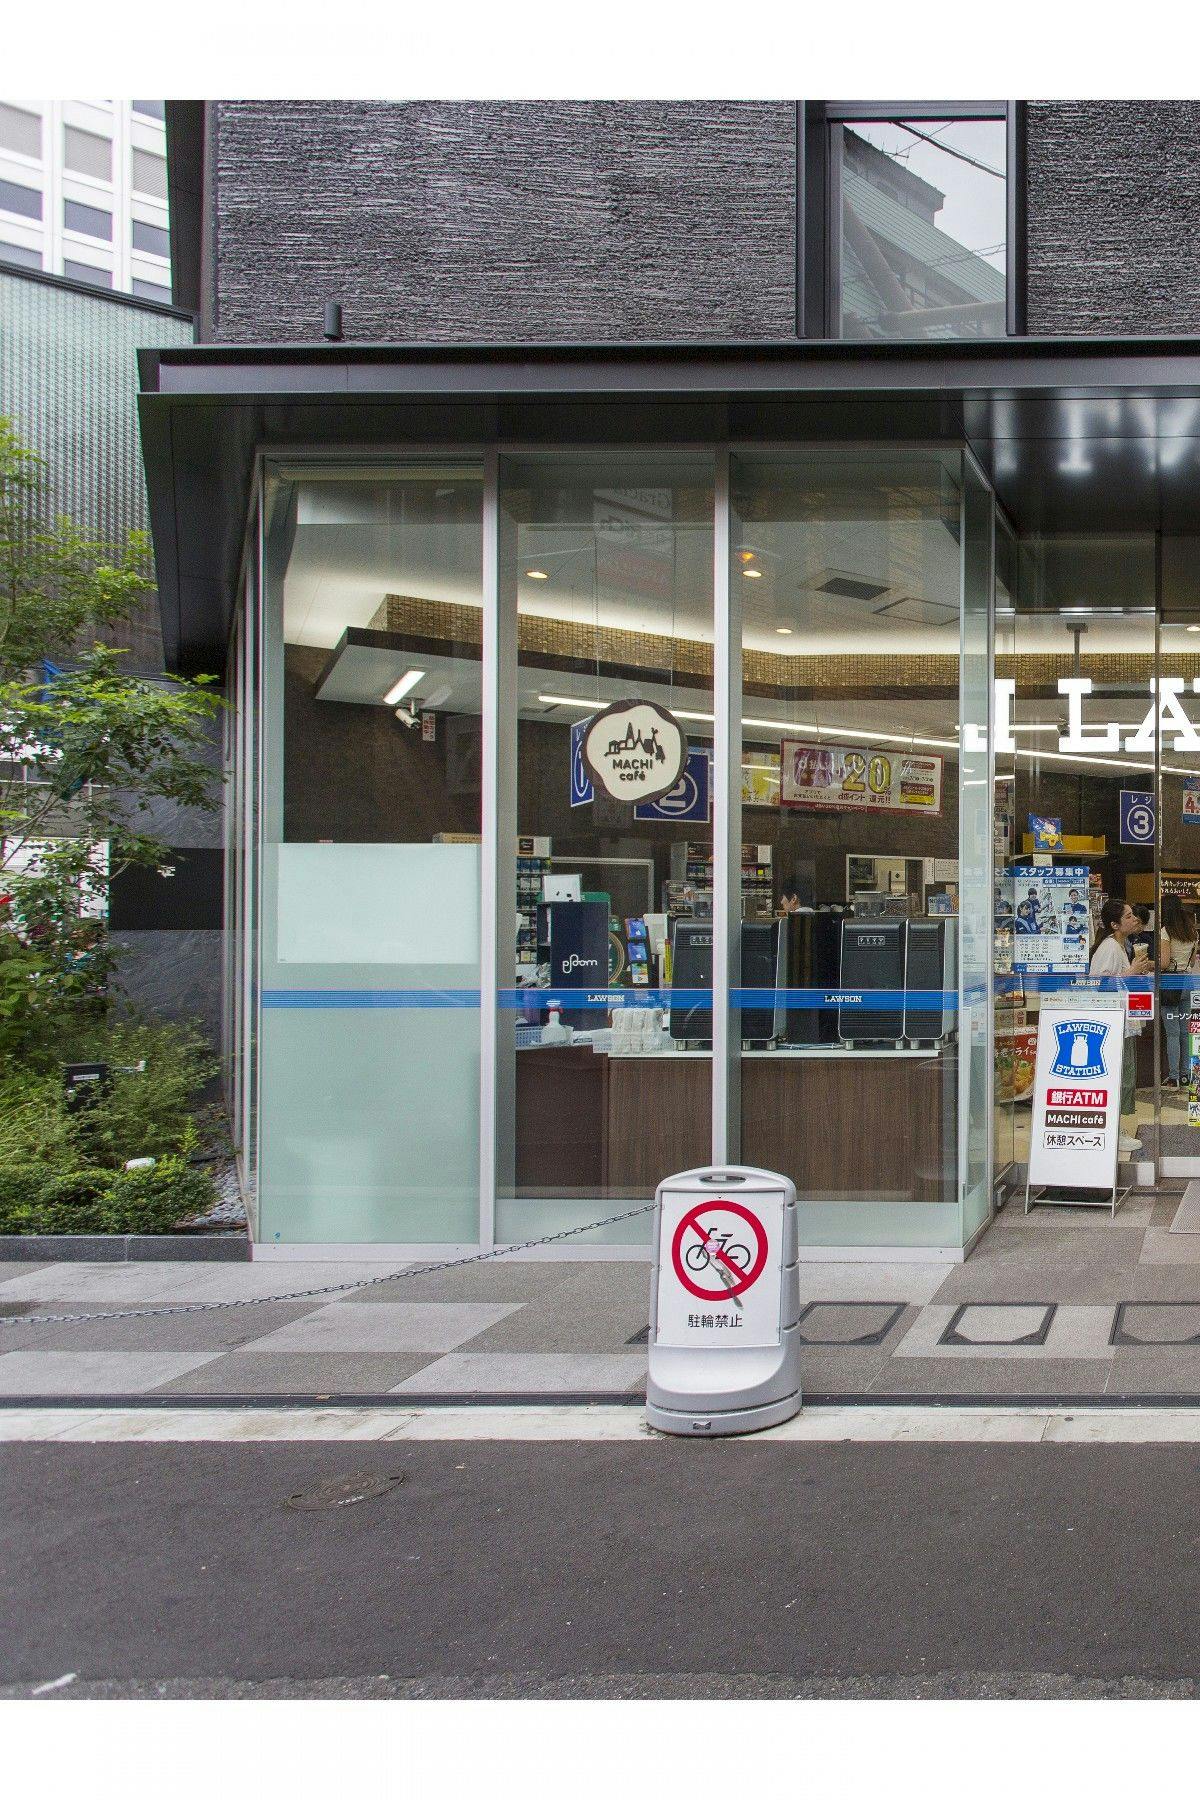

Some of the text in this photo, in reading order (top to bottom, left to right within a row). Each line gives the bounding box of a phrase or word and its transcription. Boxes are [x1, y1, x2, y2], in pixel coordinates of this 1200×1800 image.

[612, 758, 653, 770] MACHI
[619, 770, 646, 781] café
[1131, 794, 1152, 805] レジ
[1133, 810, 1150, 835] 3
[1019, 867, 1084, 877] スタッフ募集中
[588, 994, 625, 1002] LAWSON
[824, 995, 863, 1003] LAWSON
[1058, 1023, 1105, 1036] LAWSON
[1056, 1064, 1102, 1077] STATION
[1050, 1090, 1104, 1105] 銀行ATM
[1047, 1113, 1104, 1125] MACHI café
[1046, 1133, 1102, 1147] 休憩スペース
[687, 1313, 743, 1328] 駐輪禁止
